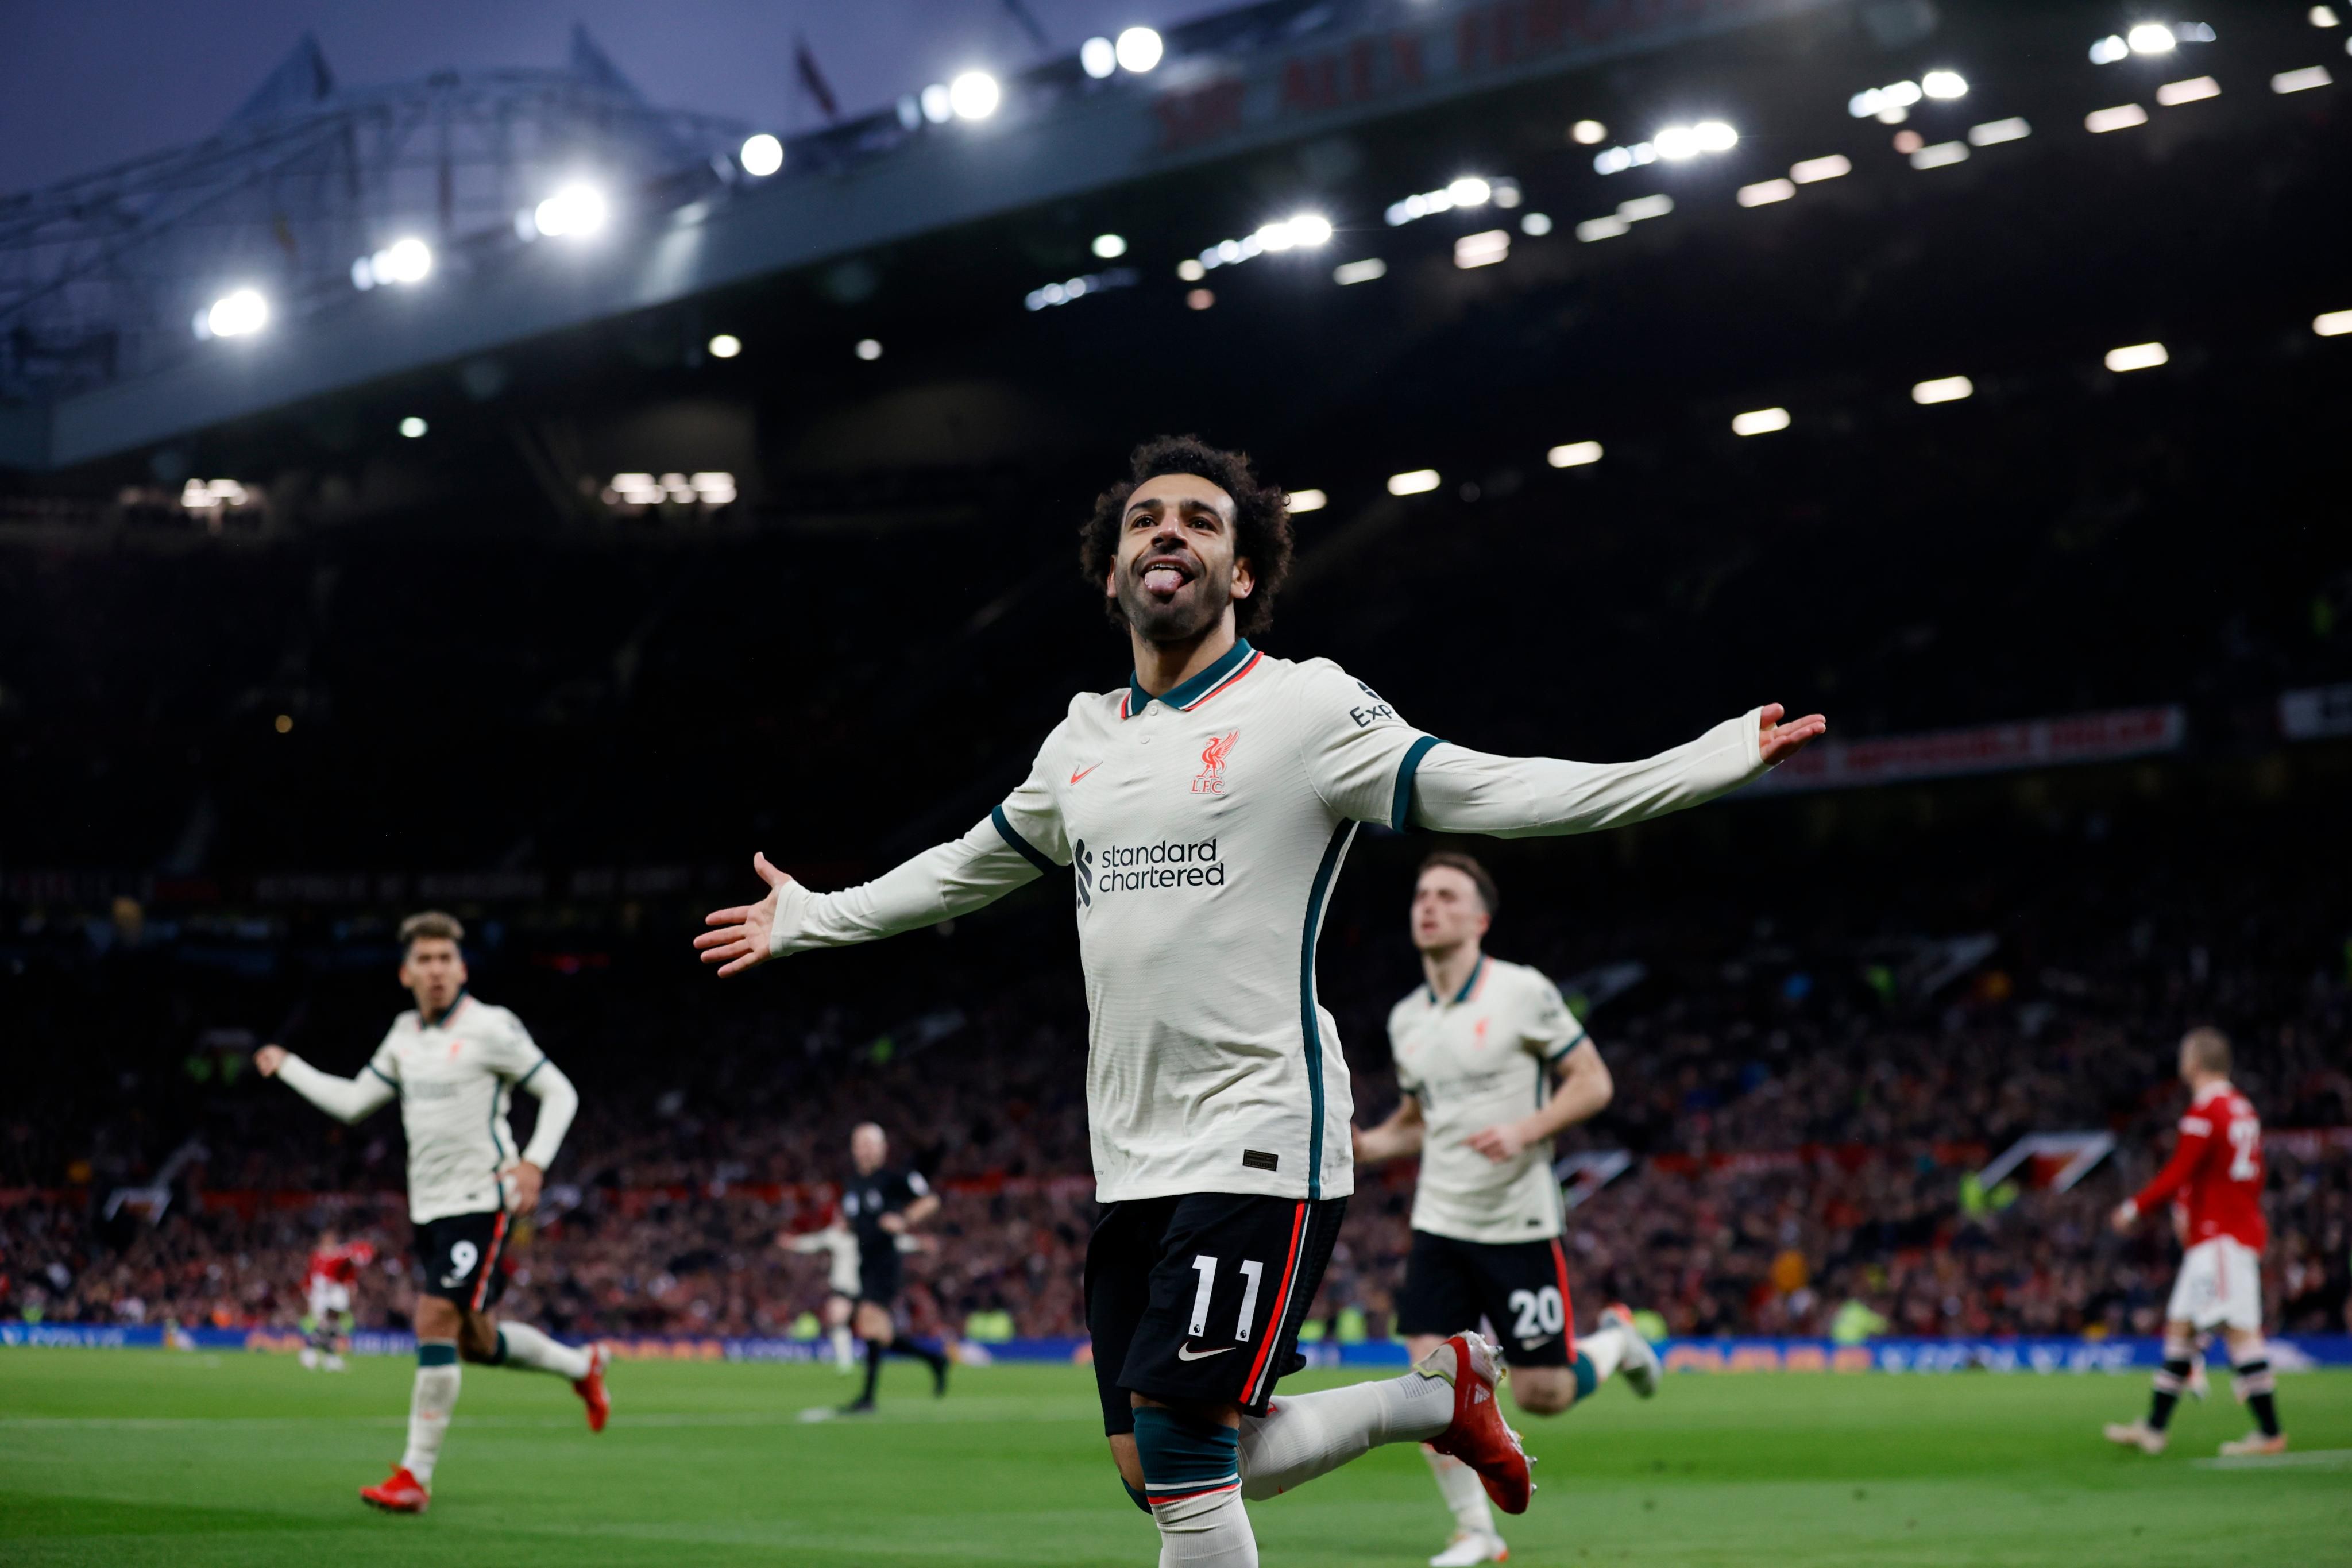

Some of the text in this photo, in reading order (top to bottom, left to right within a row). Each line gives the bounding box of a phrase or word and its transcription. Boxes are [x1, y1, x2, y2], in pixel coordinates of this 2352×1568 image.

[1101, 837, 1216, 868] standard
[1099, 862, 1225, 893] chartered
[450, 1240, 478, 1280] 9
[1188, 1254, 1264, 1343] 11
[1508, 1285, 1565, 1338] 20
